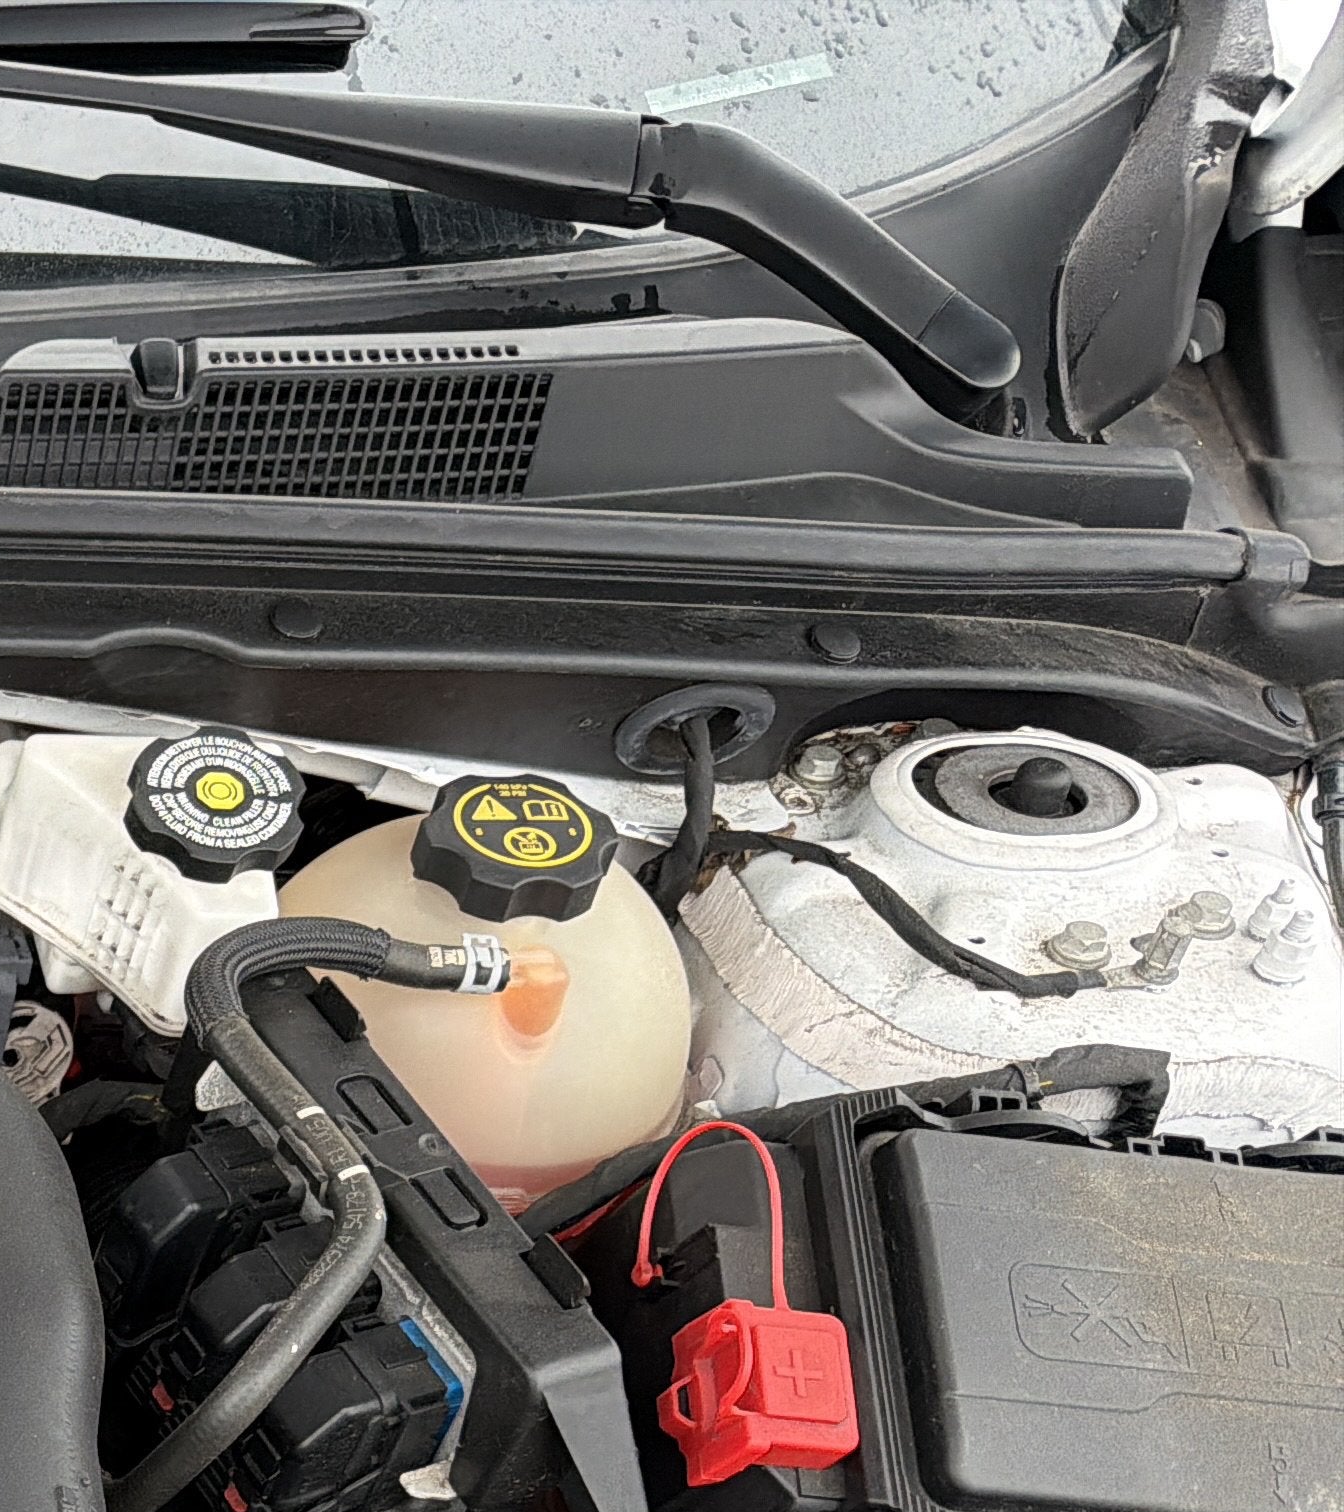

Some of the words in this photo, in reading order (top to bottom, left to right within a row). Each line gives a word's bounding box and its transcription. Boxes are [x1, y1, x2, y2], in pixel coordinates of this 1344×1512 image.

[215, 736, 254, 755] BOUCHON
[161, 813, 188, 835] FLUID
[186, 829, 215, 847] FROM
[215, 838, 223, 848] A
[224, 834, 260, 849] SEALED
[171, 808, 205, 833] BEFORE
[213, 816, 245, 827] CLEAN
